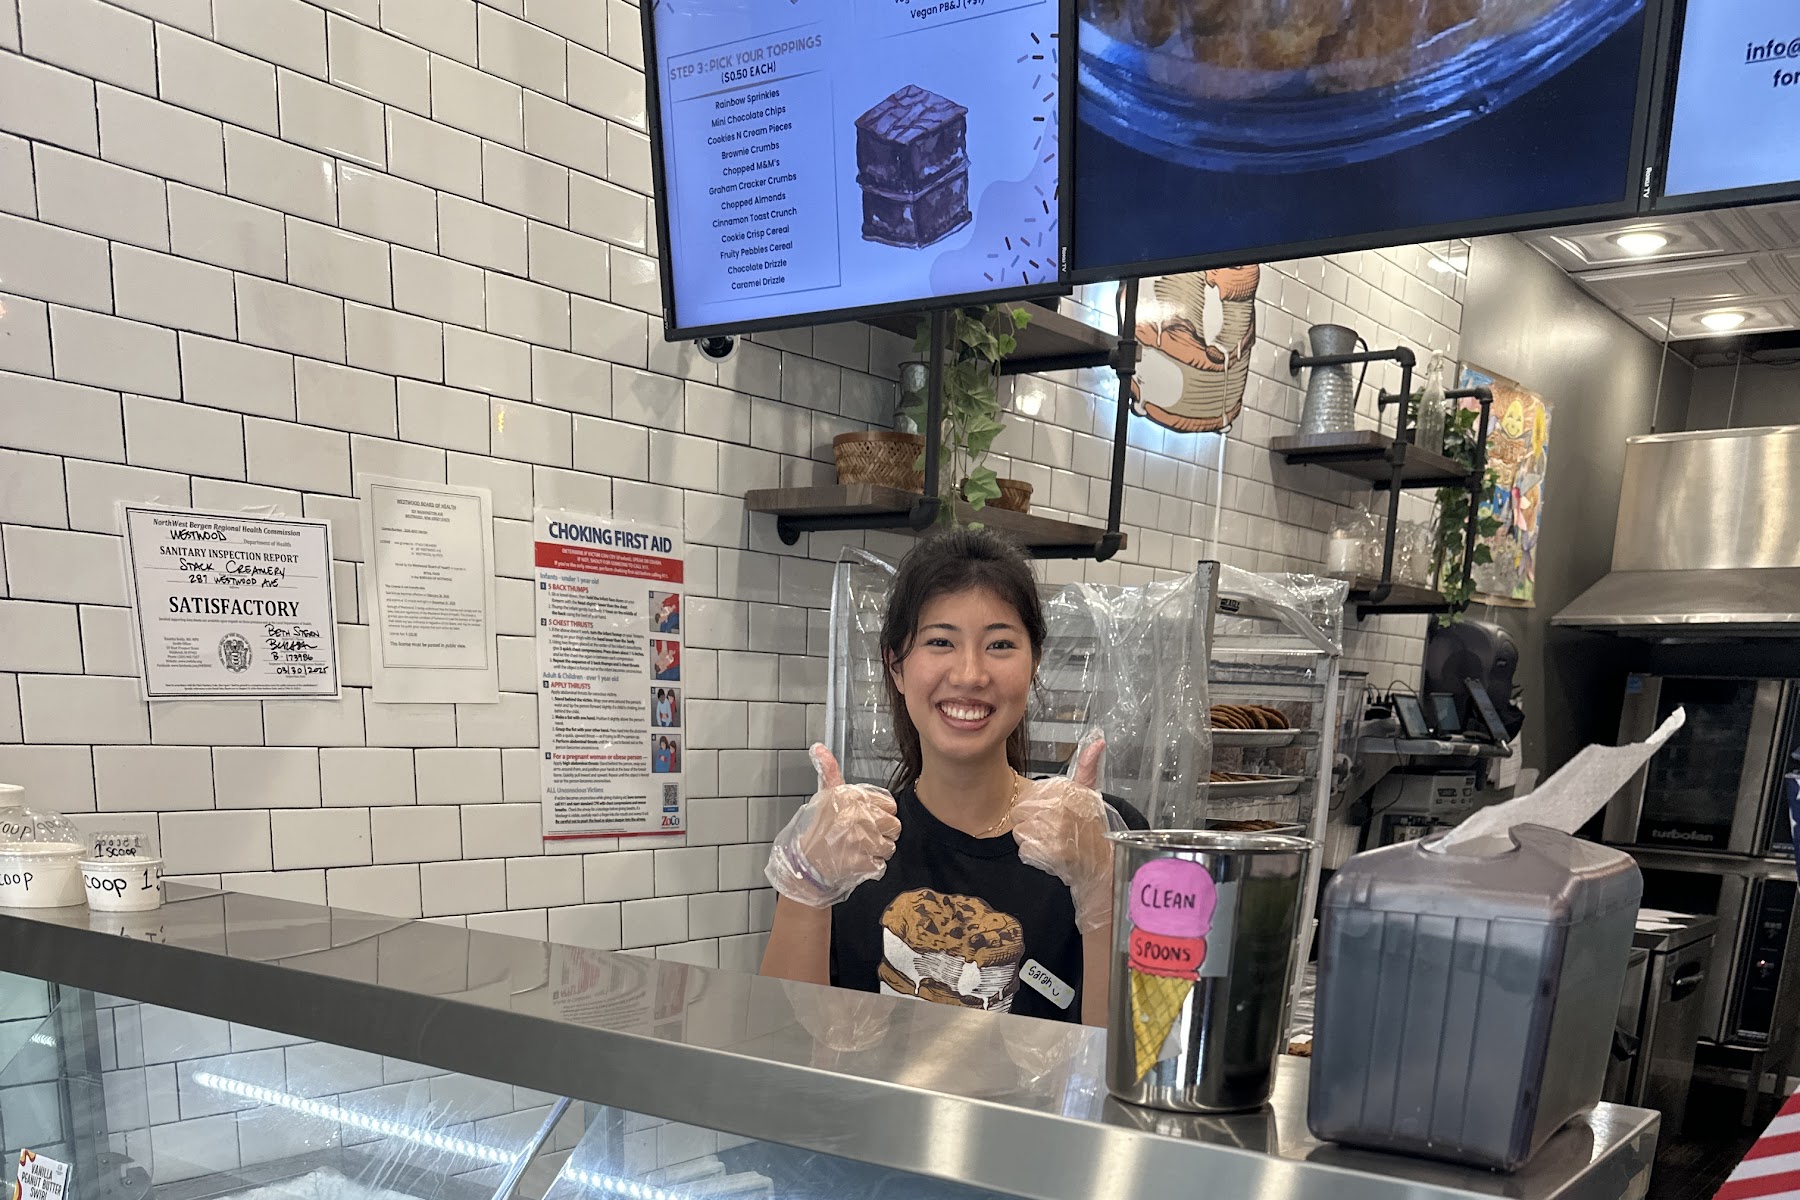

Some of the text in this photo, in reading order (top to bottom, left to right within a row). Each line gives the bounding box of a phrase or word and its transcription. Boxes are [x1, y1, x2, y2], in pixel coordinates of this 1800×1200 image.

[910, 7, 938, 19] Vegan
[940, 0, 960, 12] PB&J
[670, 64, 694, 80] STEP
[710, 56, 733, 72] PICK
[736, 48, 764, 65] YOUR
[766, 34, 822, 58] TOPPINGS
[750, 61, 776, 78] EACH)
[715, 89, 780, 110] Rainbow Sprinkles
[711, 105, 786, 128] Mini Chocolate Chips
[707, 121, 792, 145] Cookies N Cream Pieces
[721, 141, 780, 160] Brownie Crumbs
[722, 158, 780, 176] Chopped M&M's
[709, 173, 797, 195] Graham Cracker Crumbs
[1643, 187, 1650, 198] TV
[721, 192, 786, 210] Chopped Almonds
[712, 207, 797, 228] Cinnamon Toast Crunch
[721, 225, 790, 243] Cookie Crisp Cereal
[720, 241, 793, 260] Fruity Pebbles Cereal
[728, 259, 787, 275] Chocolate Drizzle
[731, 275, 785, 290] Caramel Drizzle
[153, 518, 301, 537] NorthWest Bergen Regional Health Commission
[170, 530, 227, 542] WESTWOOD
[549, 522, 672, 553] CHOKING FIRST AID
[160, 546, 298, 564] SANITARY INSPECTION REPORT
[214, 575, 257, 586] WESTWOOD
[169, 596, 300, 617] SATISFACTORY
[566, 754, 588, 762] pregnant
[0, 821, 32, 840] oop
[1652, 828, 1713, 841] turbofan
[1141, 884, 1196, 910] CLEAN
[1134, 942, 1191, 962] SPOONS
[31, 1164, 53, 1181] VANILLA
[21, 1172, 62, 1196] PEANUT BUTTER
